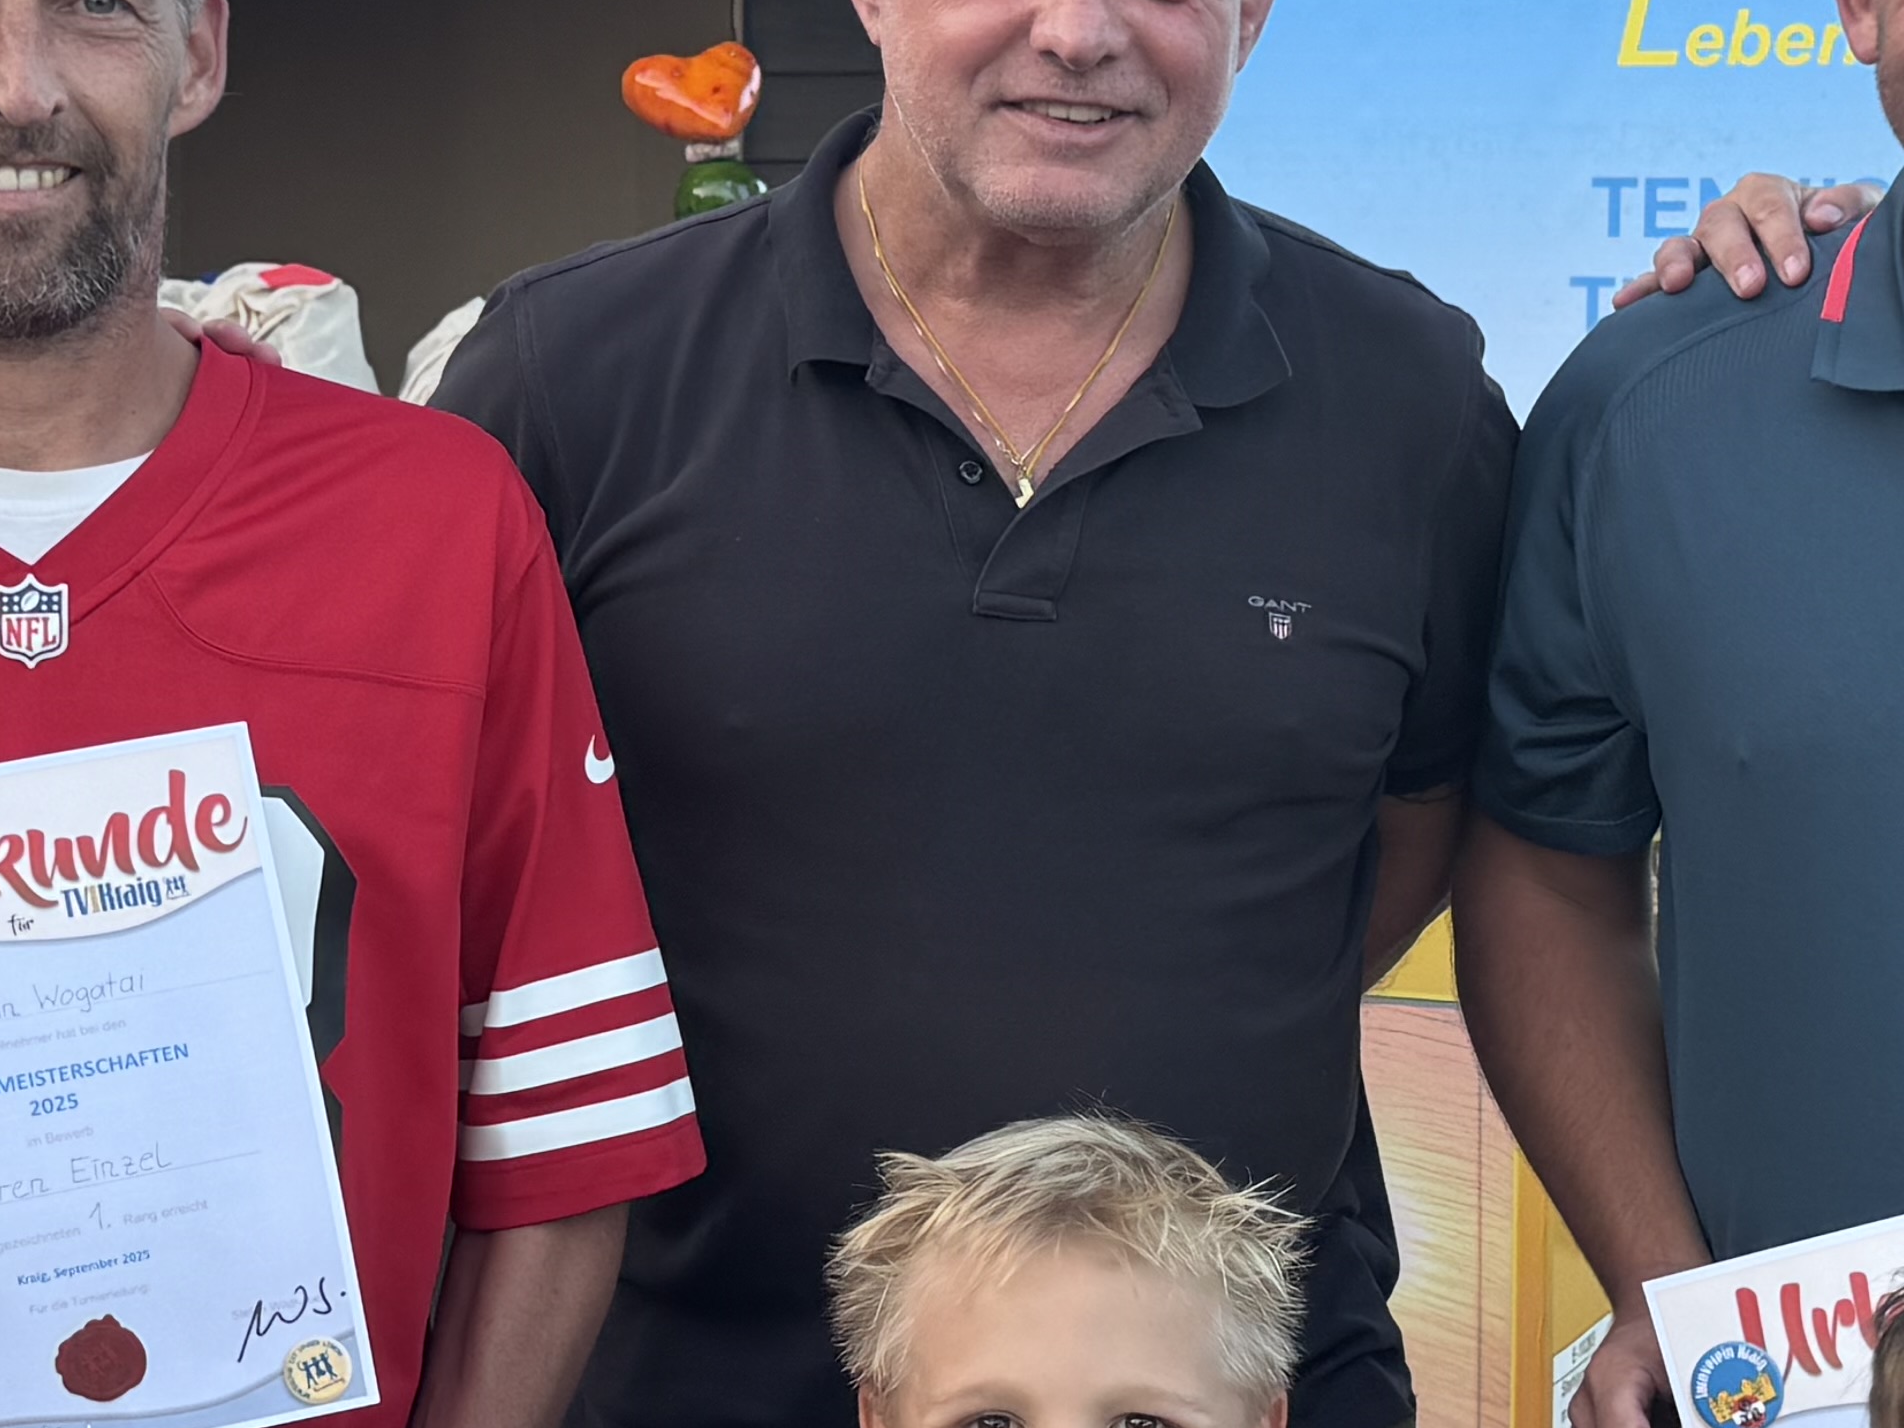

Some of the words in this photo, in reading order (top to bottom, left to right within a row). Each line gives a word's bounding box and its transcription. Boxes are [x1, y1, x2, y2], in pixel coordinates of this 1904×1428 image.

[1247, 595, 1313, 613] GANT
[5, 616, 58, 652] NFL
[7, 912, 35, 938] für
[28, 1092, 80, 1117] 2025
[69, 1140, 173, 1185] Einzel
[52, 1256, 120, 1284] September
